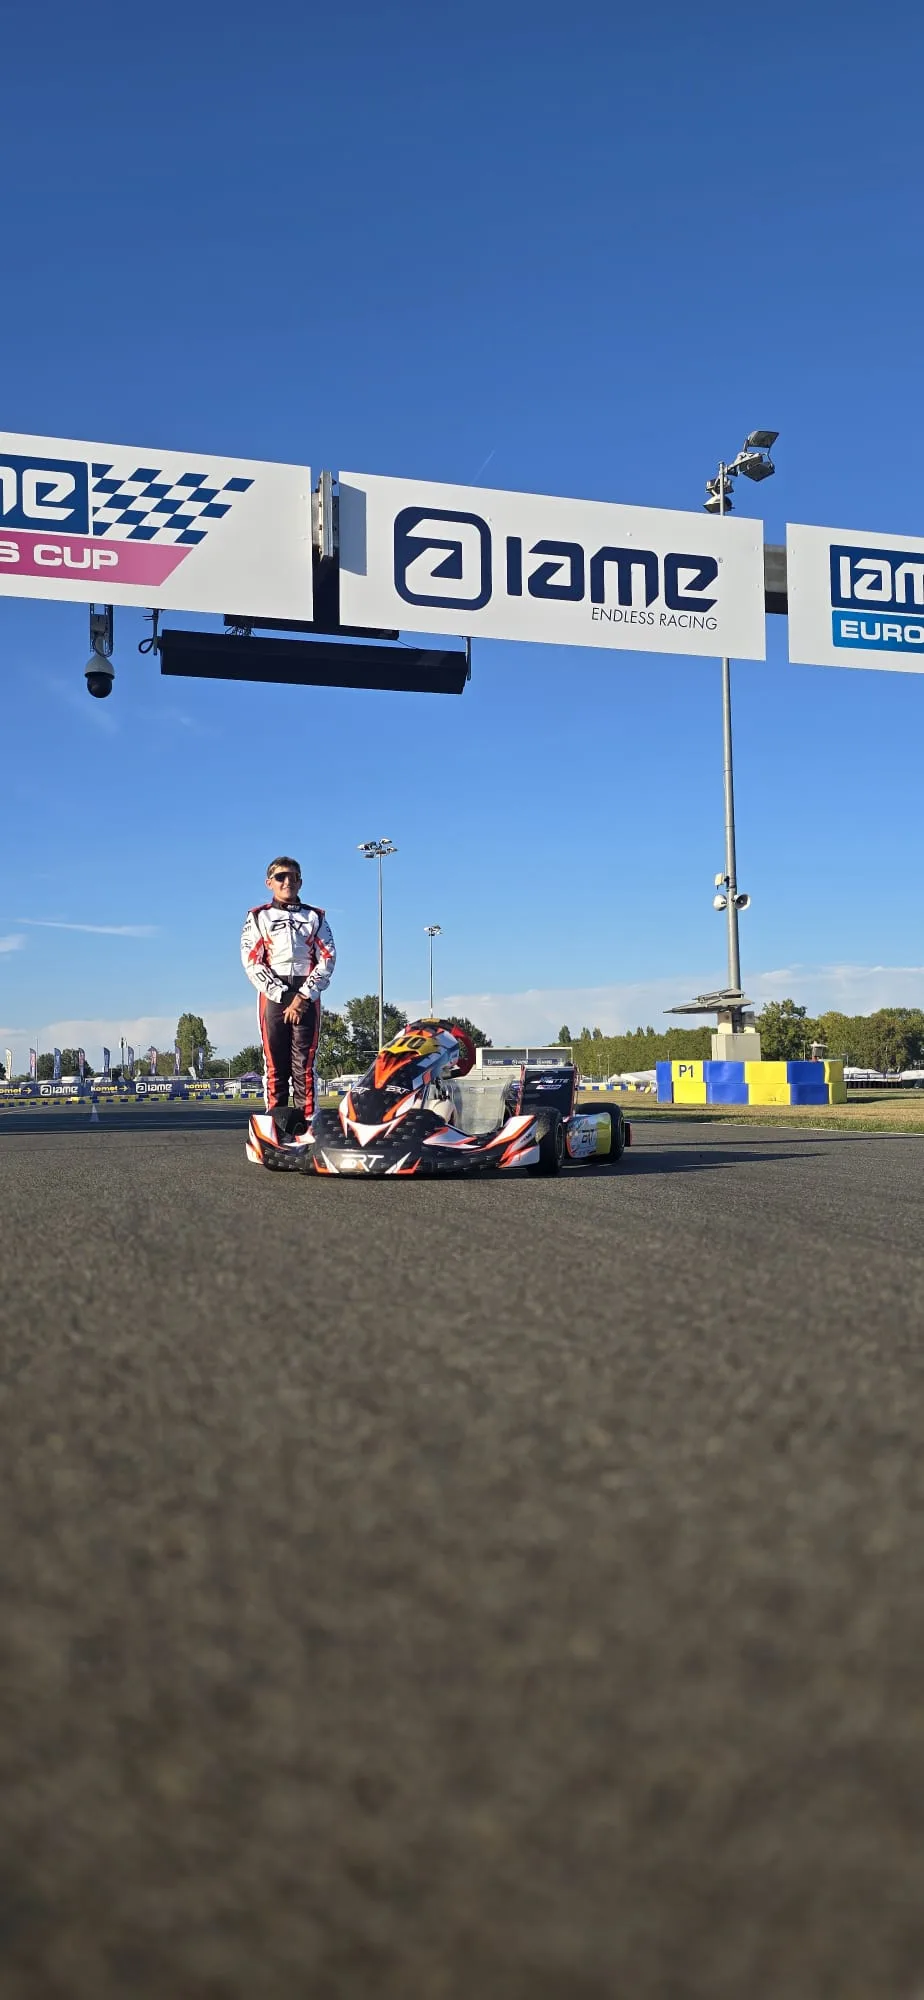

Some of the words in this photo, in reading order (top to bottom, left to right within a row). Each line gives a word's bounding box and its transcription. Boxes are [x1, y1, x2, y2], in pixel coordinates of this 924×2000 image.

[33, 544, 119, 569] CUP
[591, 607, 655, 625] ENDLESS
[659, 613, 718, 630] RACING
[840, 619, 924, 644] EURO
[678, 1064, 694, 1078] P1
